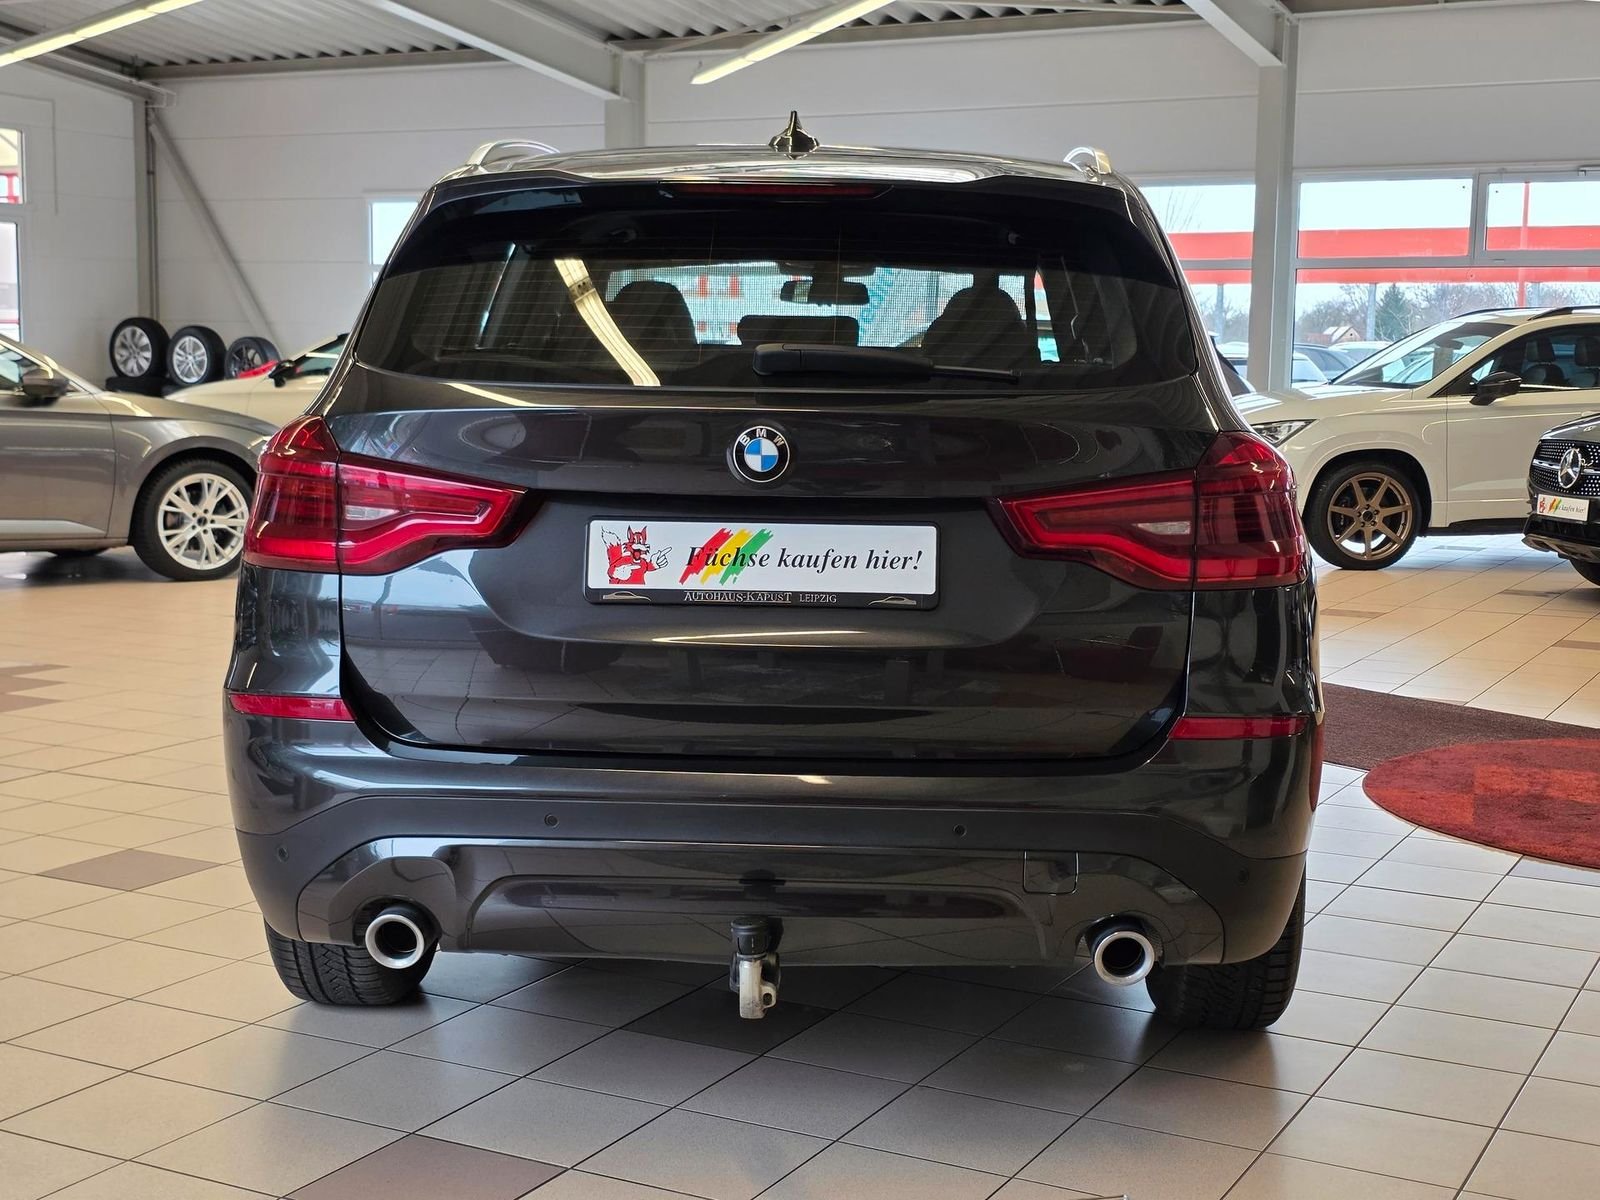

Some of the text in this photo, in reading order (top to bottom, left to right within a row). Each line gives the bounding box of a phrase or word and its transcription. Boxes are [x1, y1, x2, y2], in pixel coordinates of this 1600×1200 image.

[739, 428, 785, 447] BMW
[686, 546, 923, 573] Füchse kaufen hier!
[799, 592, 838, 604] LEIPZIG
